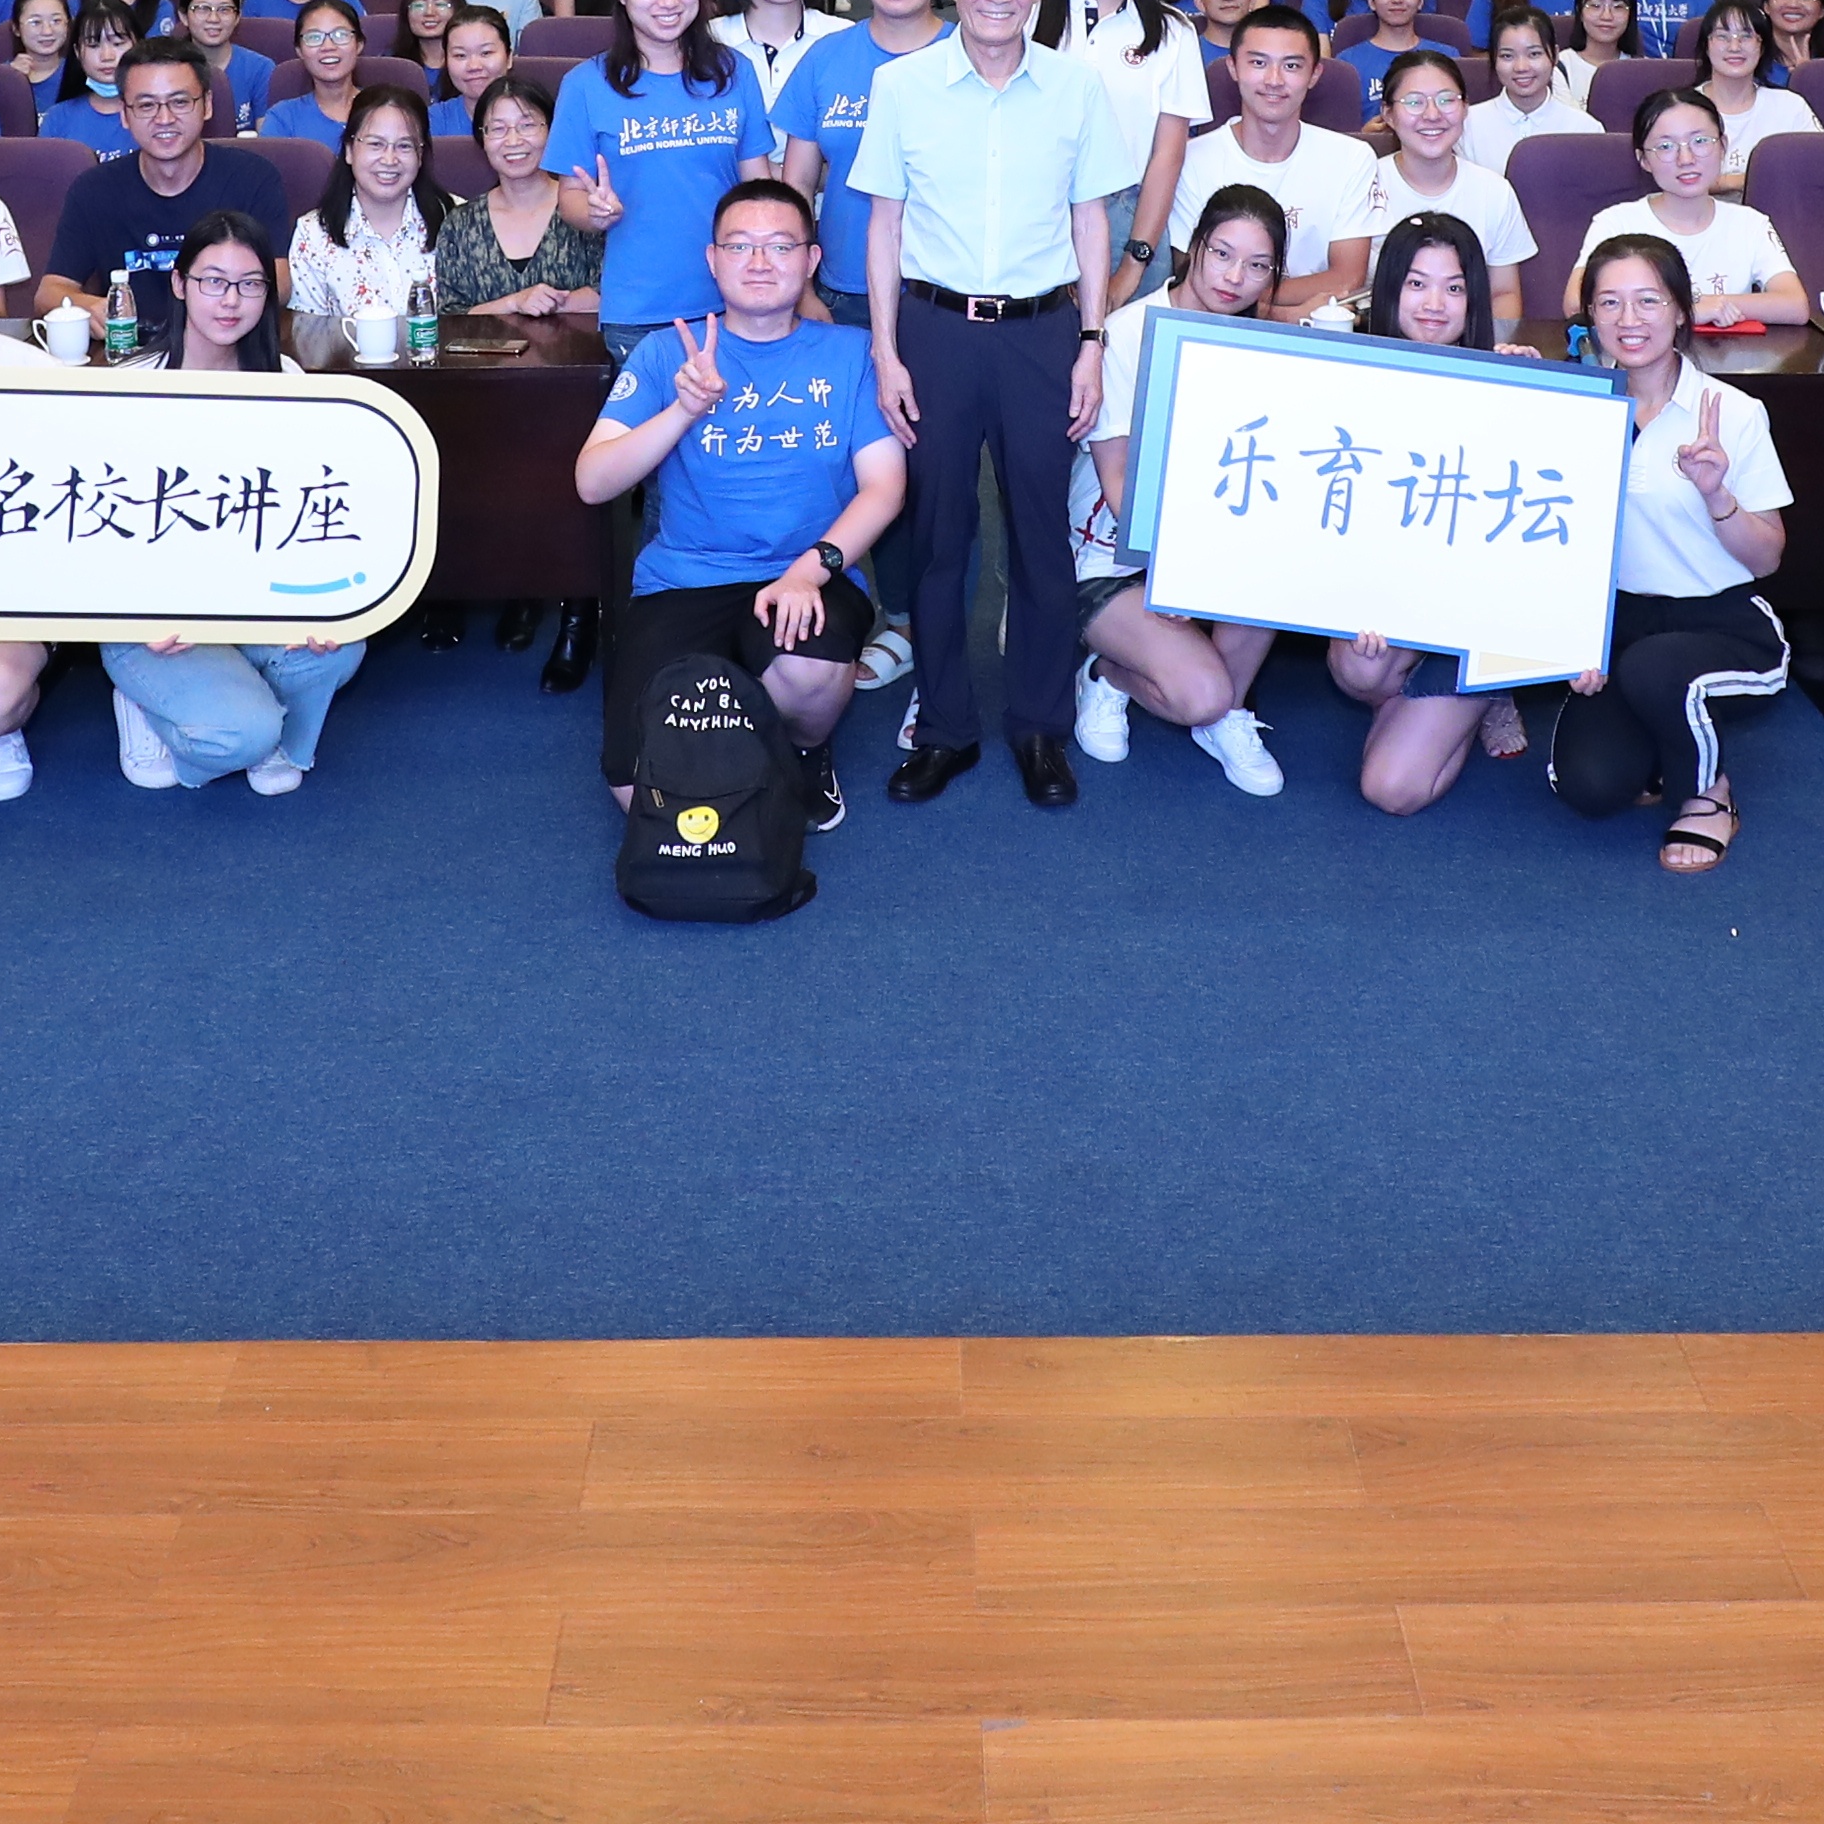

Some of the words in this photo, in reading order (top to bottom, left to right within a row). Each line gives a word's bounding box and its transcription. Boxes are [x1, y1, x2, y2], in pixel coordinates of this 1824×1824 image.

[619, 141, 654, 156] BEIJING
[656, 138, 695, 149] NORMAL
[708, 377, 832, 413] 为人师
[701, 419, 838, 456] 行为世范
[1213, 415, 1574, 546] 乐育讲坛
[696, 676, 730, 693] YOU
[671, 695, 705, 712] CAN
[658, 844, 702, 857] MENG
[708, 841, 736, 855] HUO
